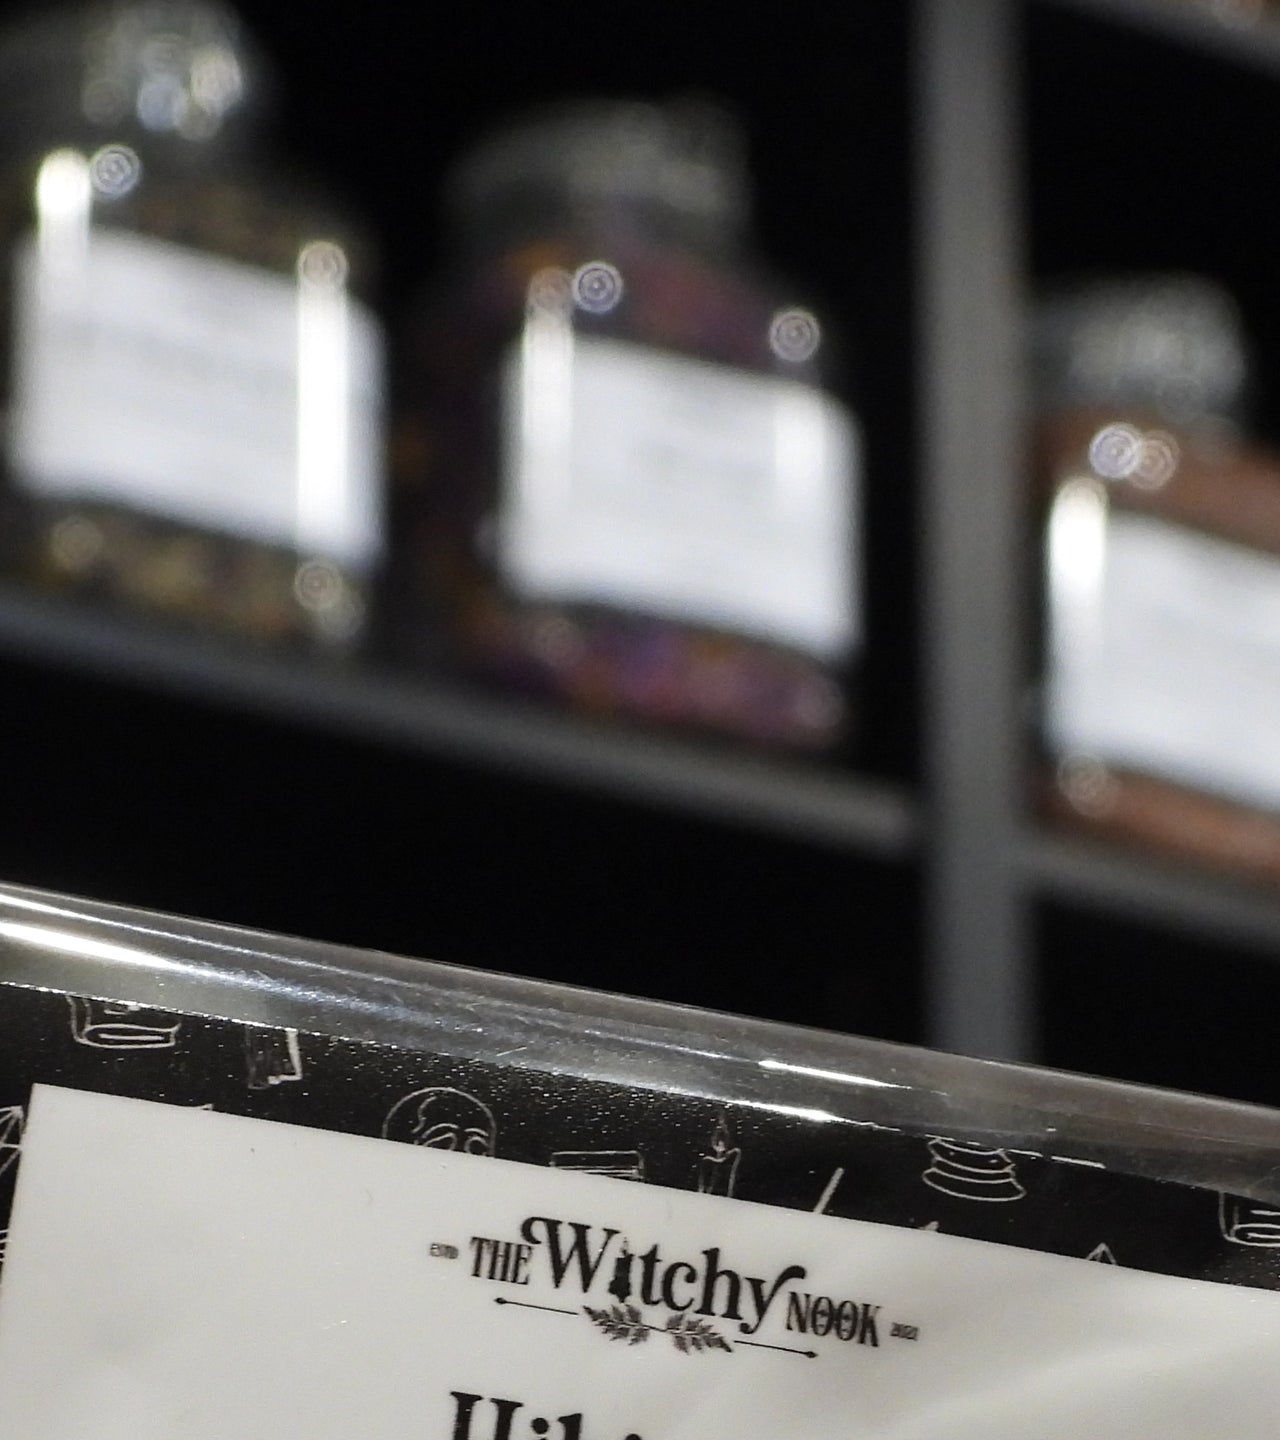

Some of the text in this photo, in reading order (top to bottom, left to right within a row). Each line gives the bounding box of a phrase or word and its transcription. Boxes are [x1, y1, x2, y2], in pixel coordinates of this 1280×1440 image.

[469, 1236, 536, 1287] THE
[520, 1216, 808, 1336] Witchy
[786, 1290, 883, 1348] NOOK
